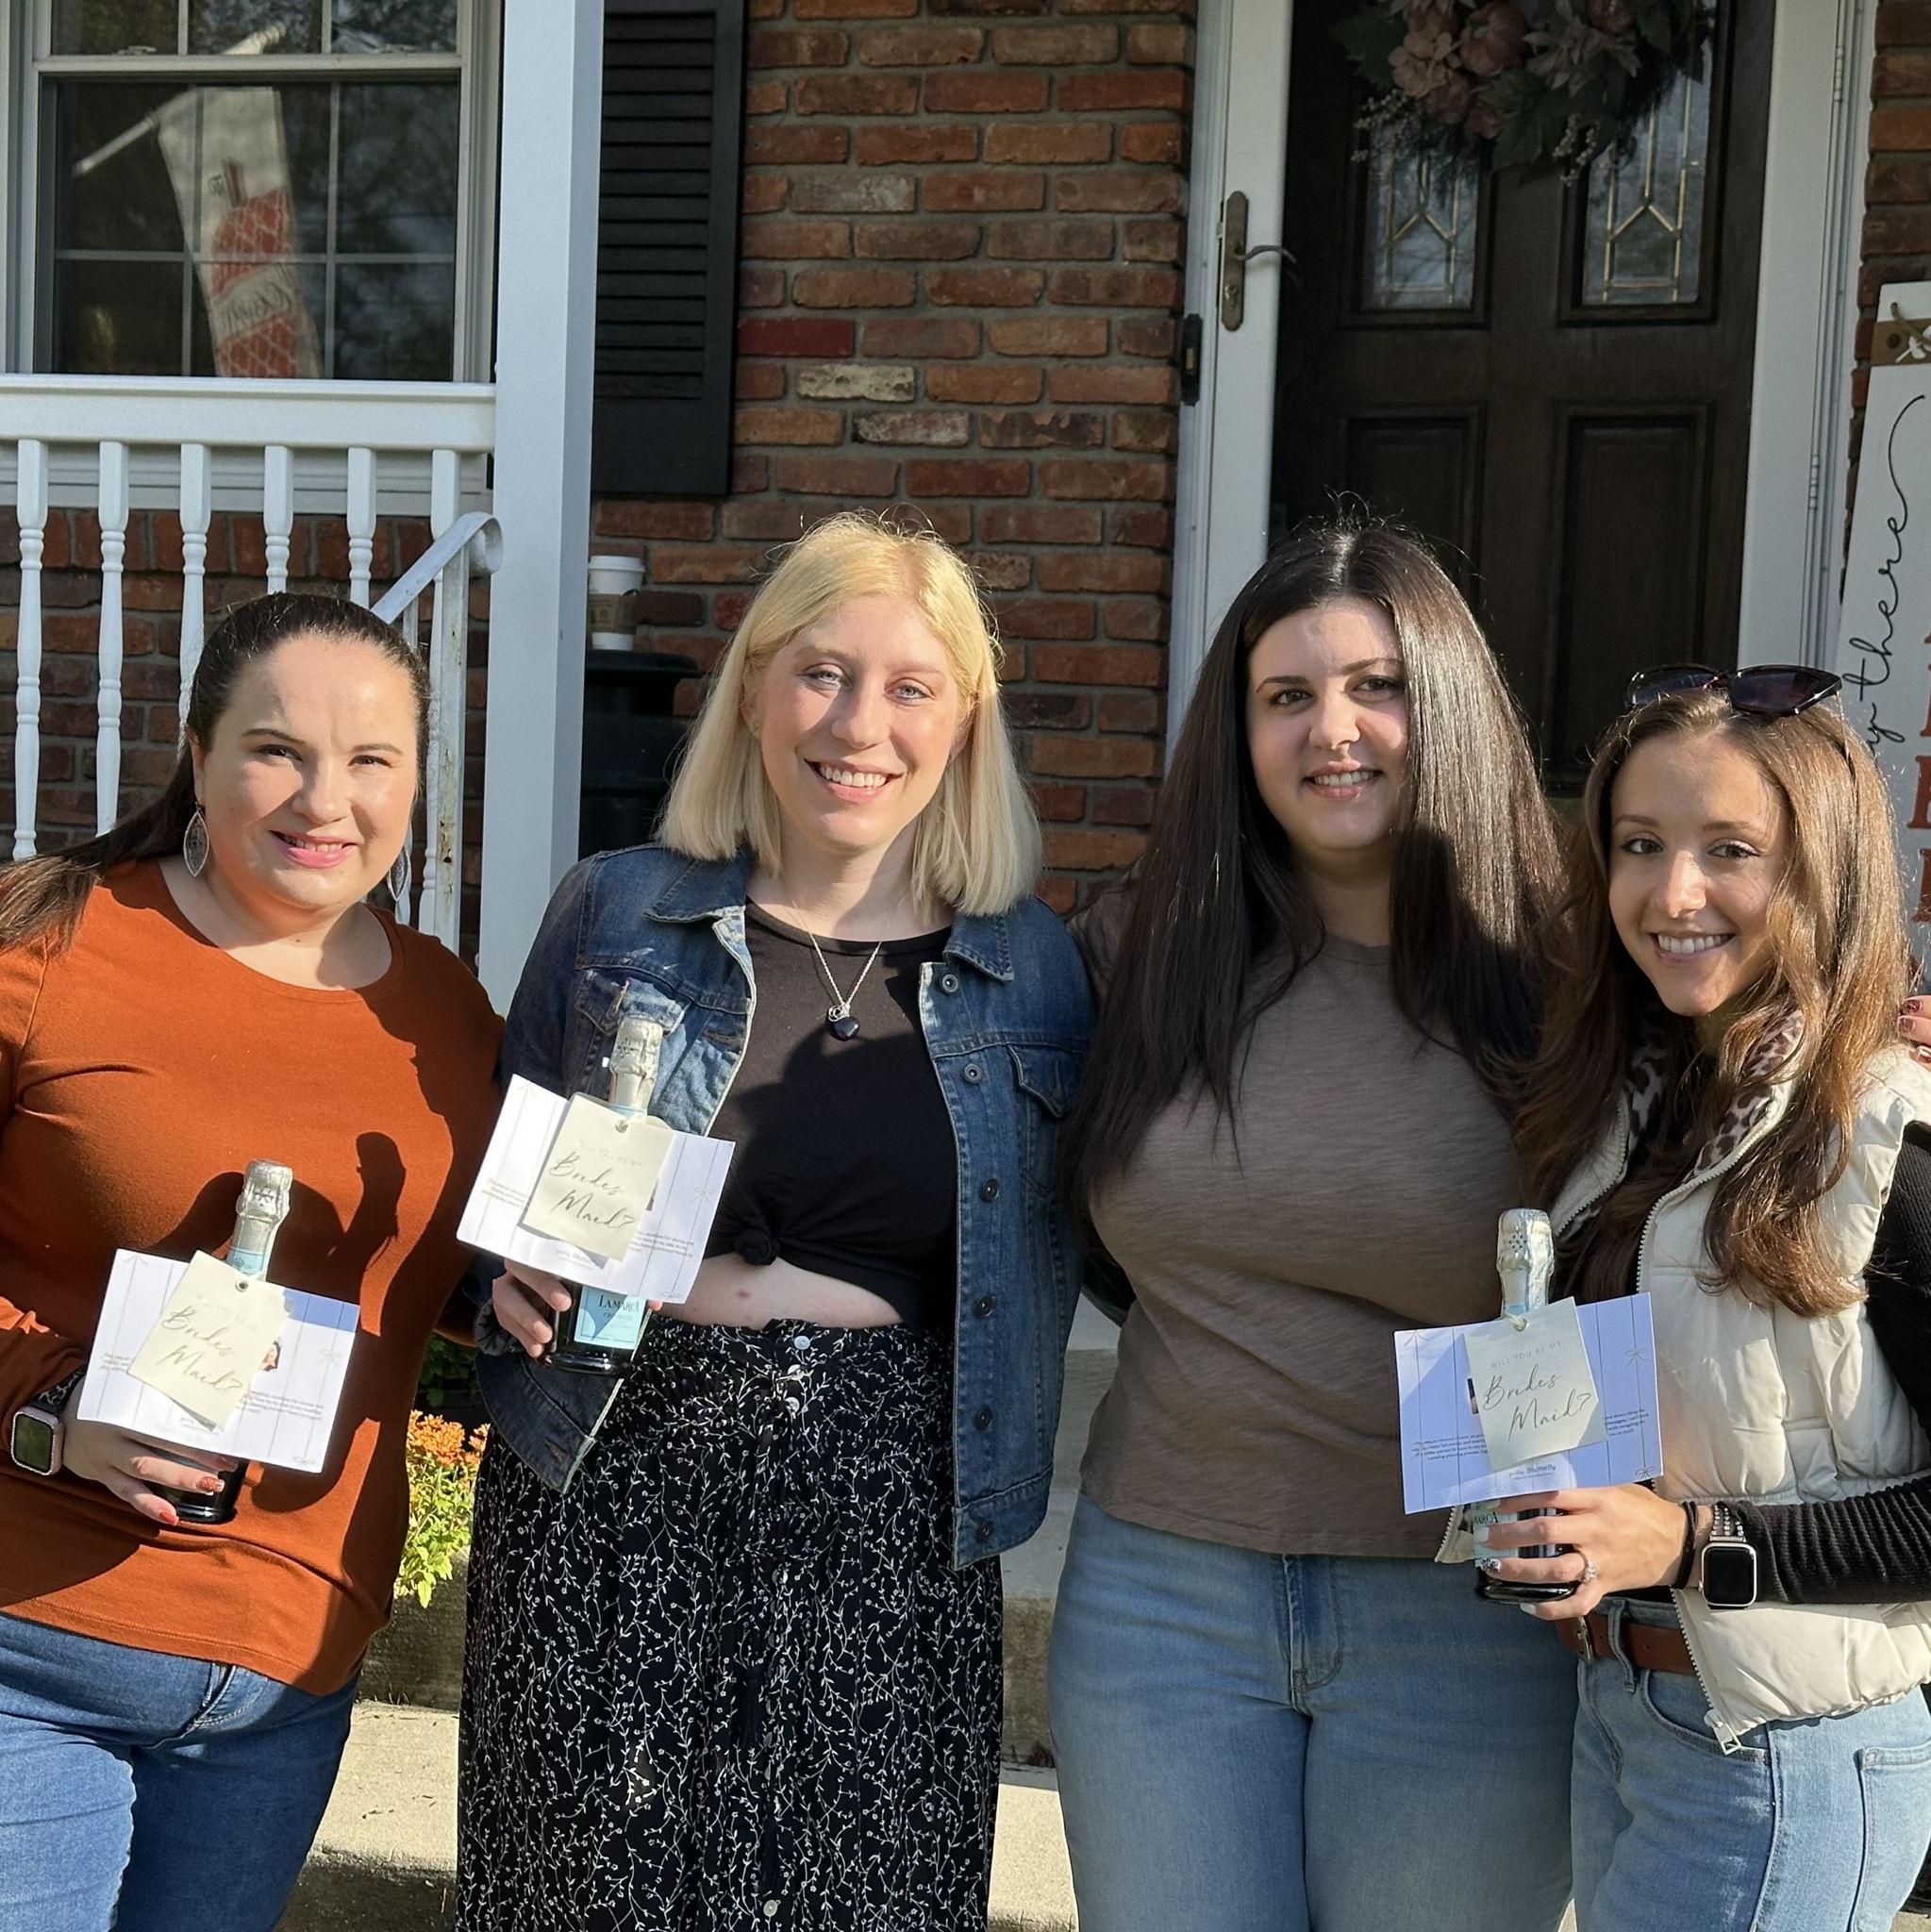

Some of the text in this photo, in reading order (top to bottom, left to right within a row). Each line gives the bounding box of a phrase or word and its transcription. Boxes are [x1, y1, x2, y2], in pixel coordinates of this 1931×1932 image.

[1841, 394, 1924, 702] there
[548, 1151, 624, 1196] Brides
[1489, 1357, 1511, 1368] WILL
[1513, 1350, 1533, 1361] YOU
[1482, 1363, 1562, 1410] Brides
[1507, 1388, 1592, 1442] Maid?
